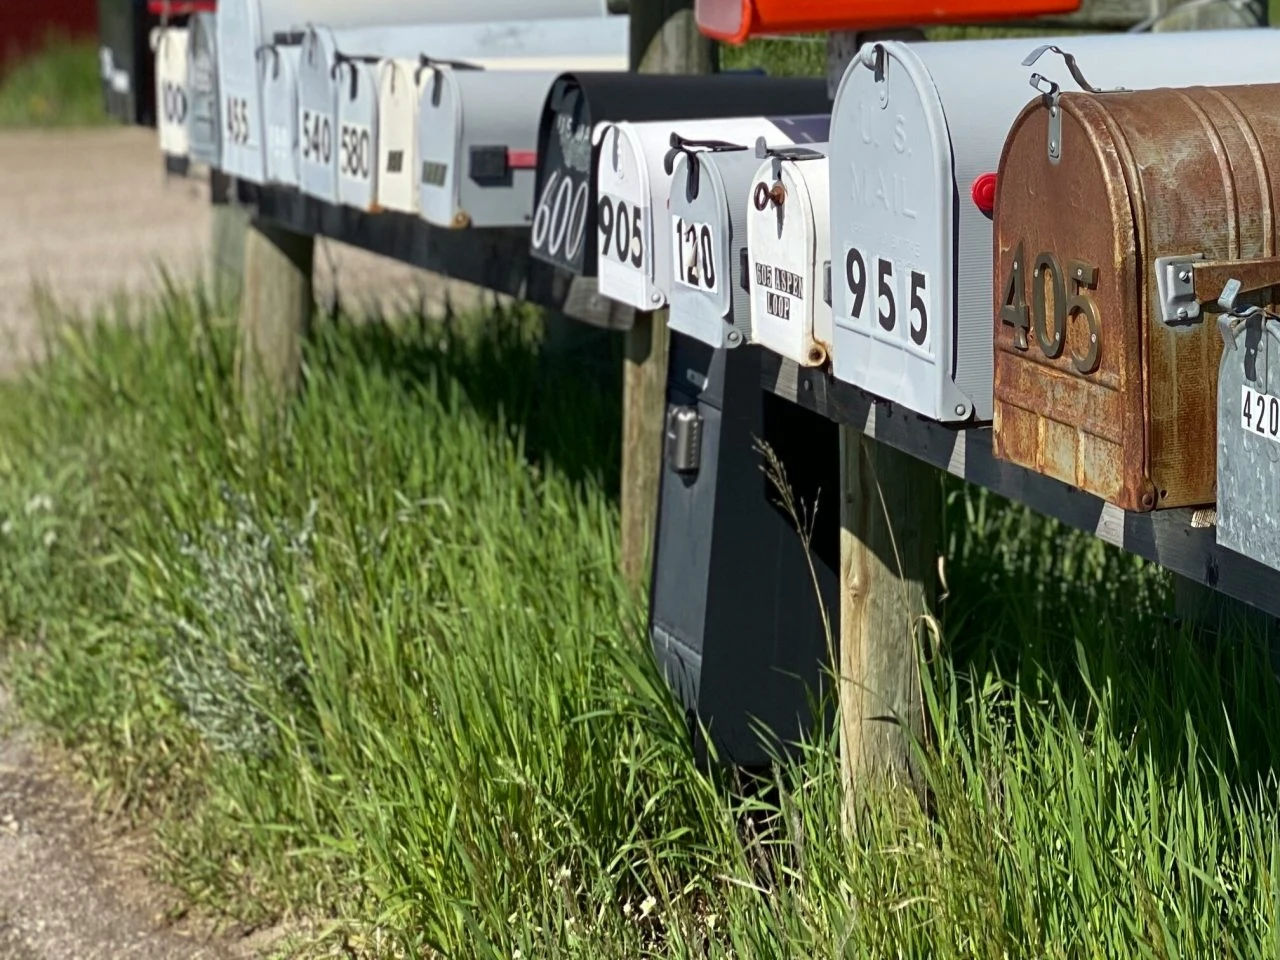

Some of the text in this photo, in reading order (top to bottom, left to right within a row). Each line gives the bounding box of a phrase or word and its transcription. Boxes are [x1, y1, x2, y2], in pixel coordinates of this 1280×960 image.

[303, 111, 331, 164] 540
[342, 125, 369, 179] 580
[531, 169, 590, 261] 600
[599, 195, 643, 269] 905
[676, 218, 716, 289] 120
[774, 267, 803, 300] ASPEN
[766, 291, 790, 320] LOOP
[846, 247, 928, 346] 955
[1000, 238, 1101, 375] 405
[1243, 390, 1279, 436] 420
